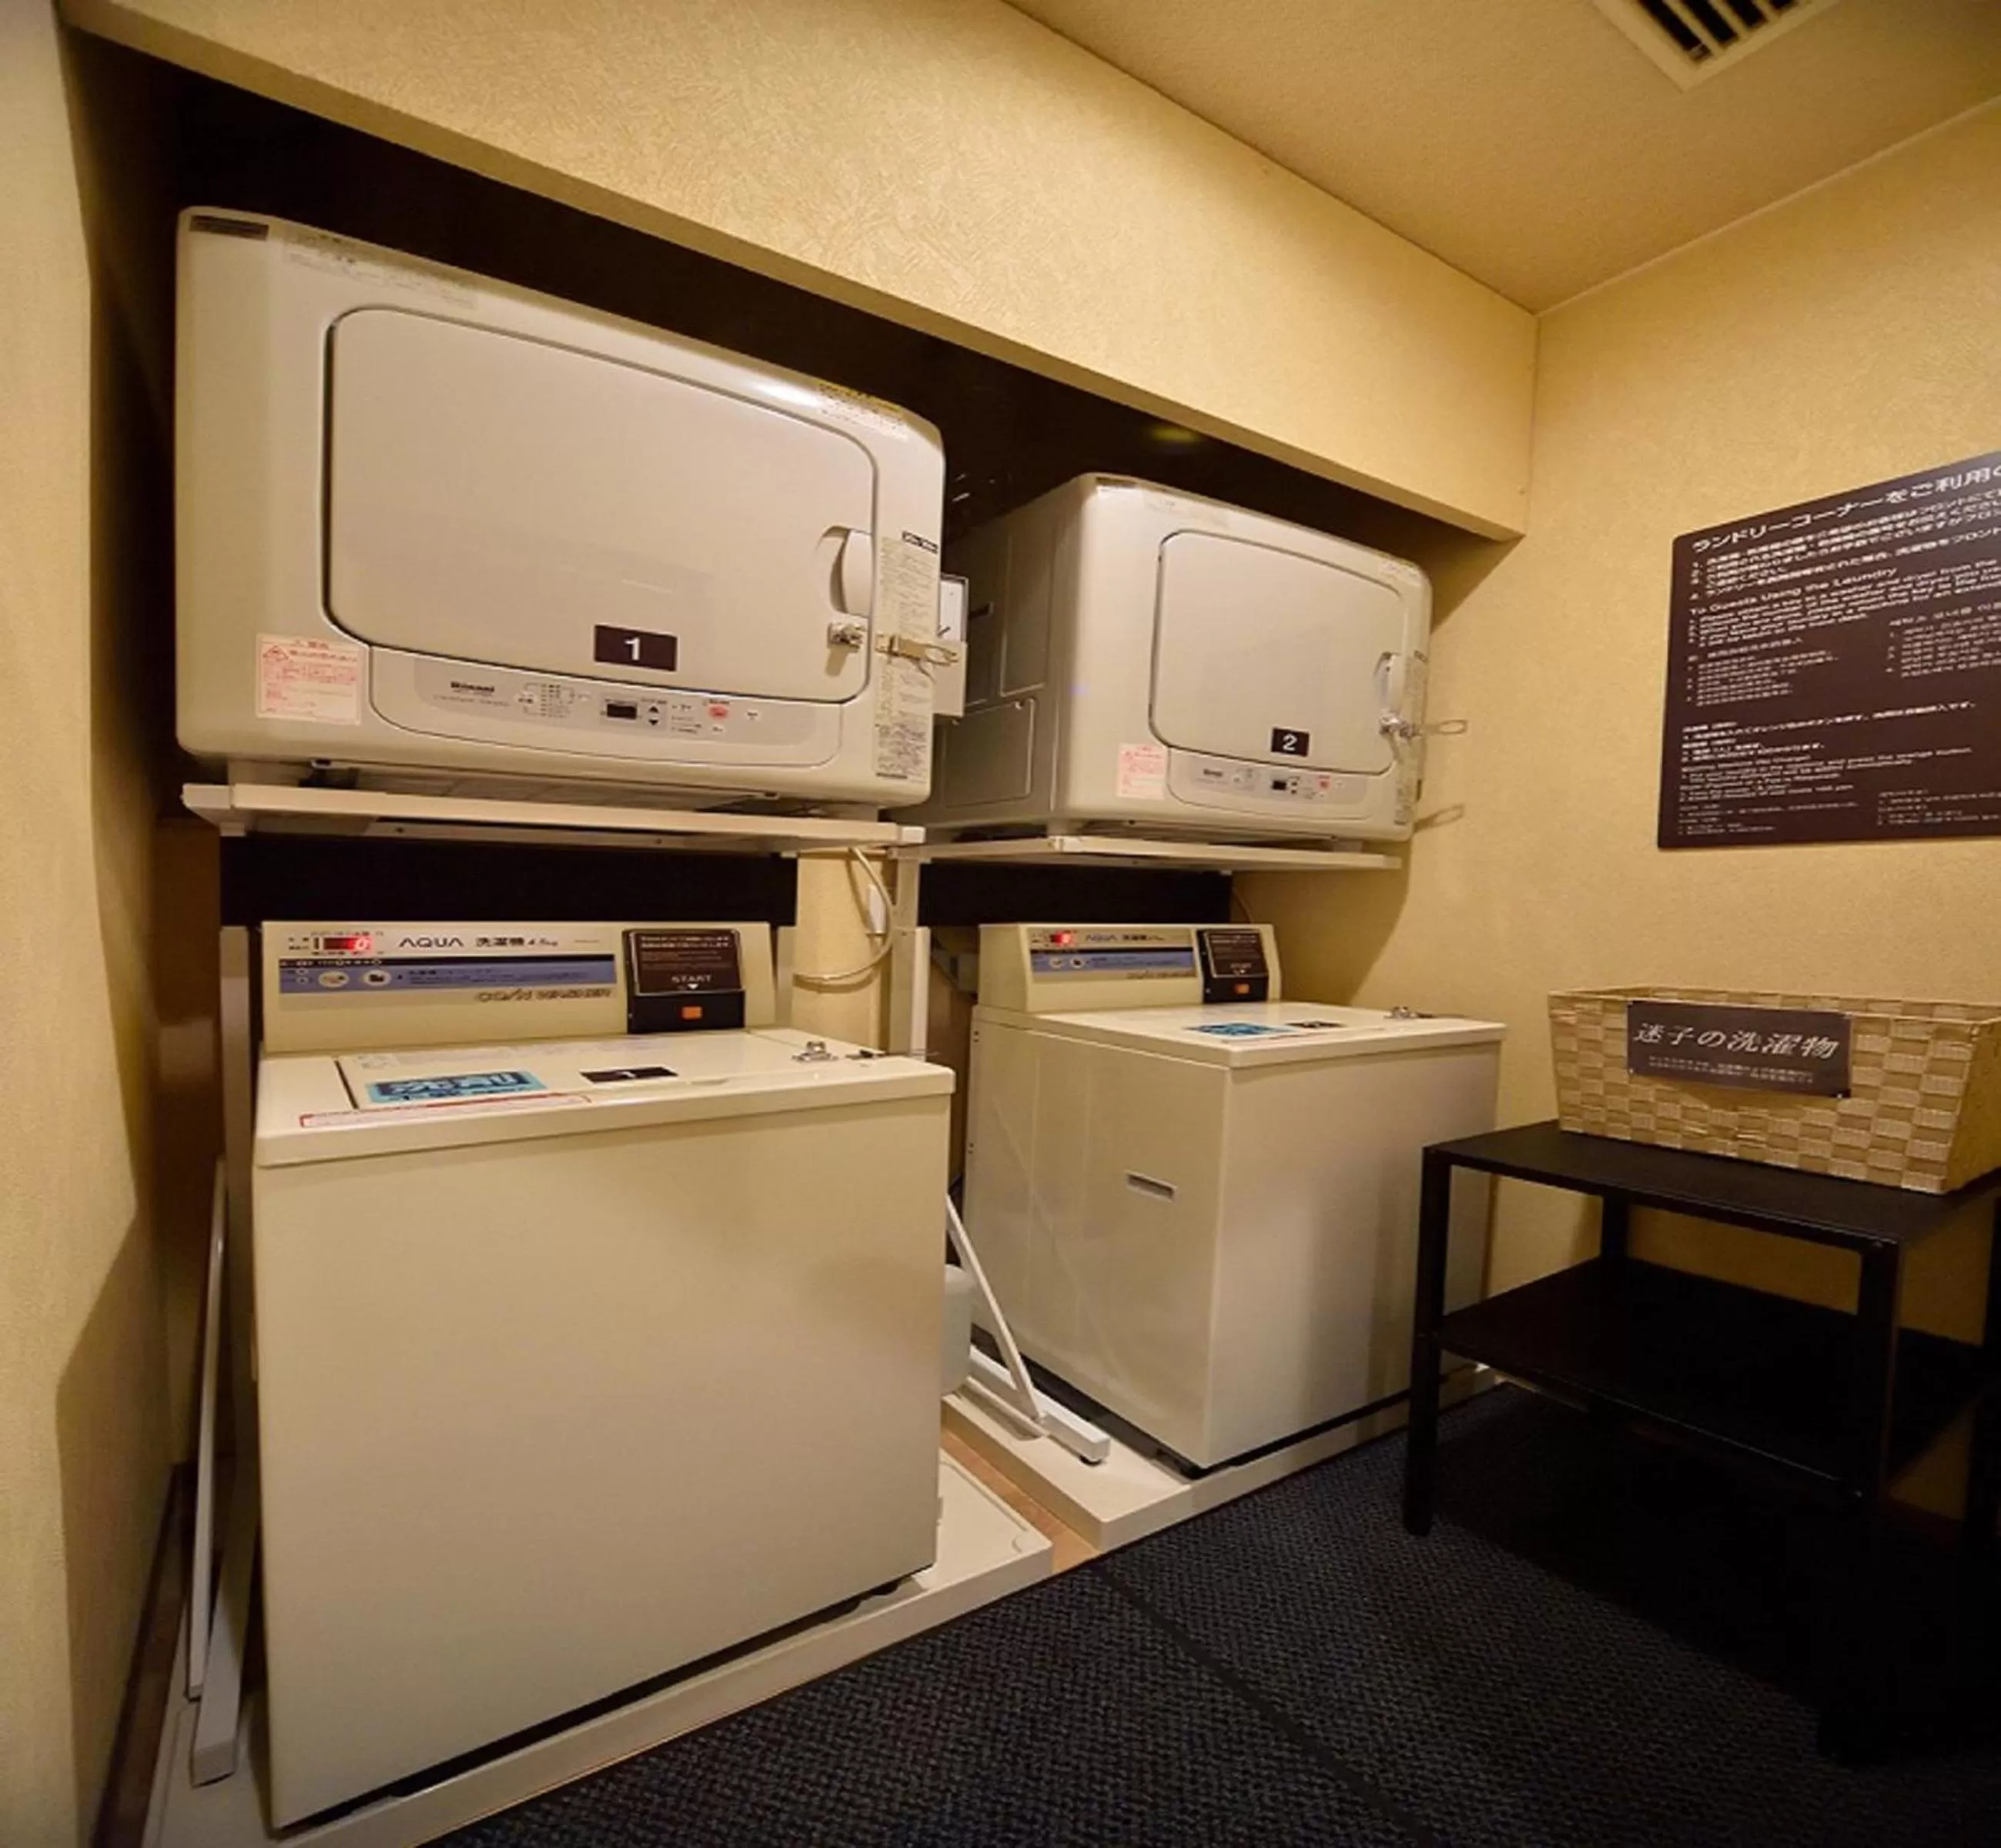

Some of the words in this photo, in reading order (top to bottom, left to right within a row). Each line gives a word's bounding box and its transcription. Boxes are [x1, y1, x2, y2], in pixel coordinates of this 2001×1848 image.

[624, 636, 641, 661] 1
[1282, 733, 1297, 752] 2
[399, 937, 464, 948] AQUA
[1632, 1023, 1841, 1059] 迷子の洗濯物
